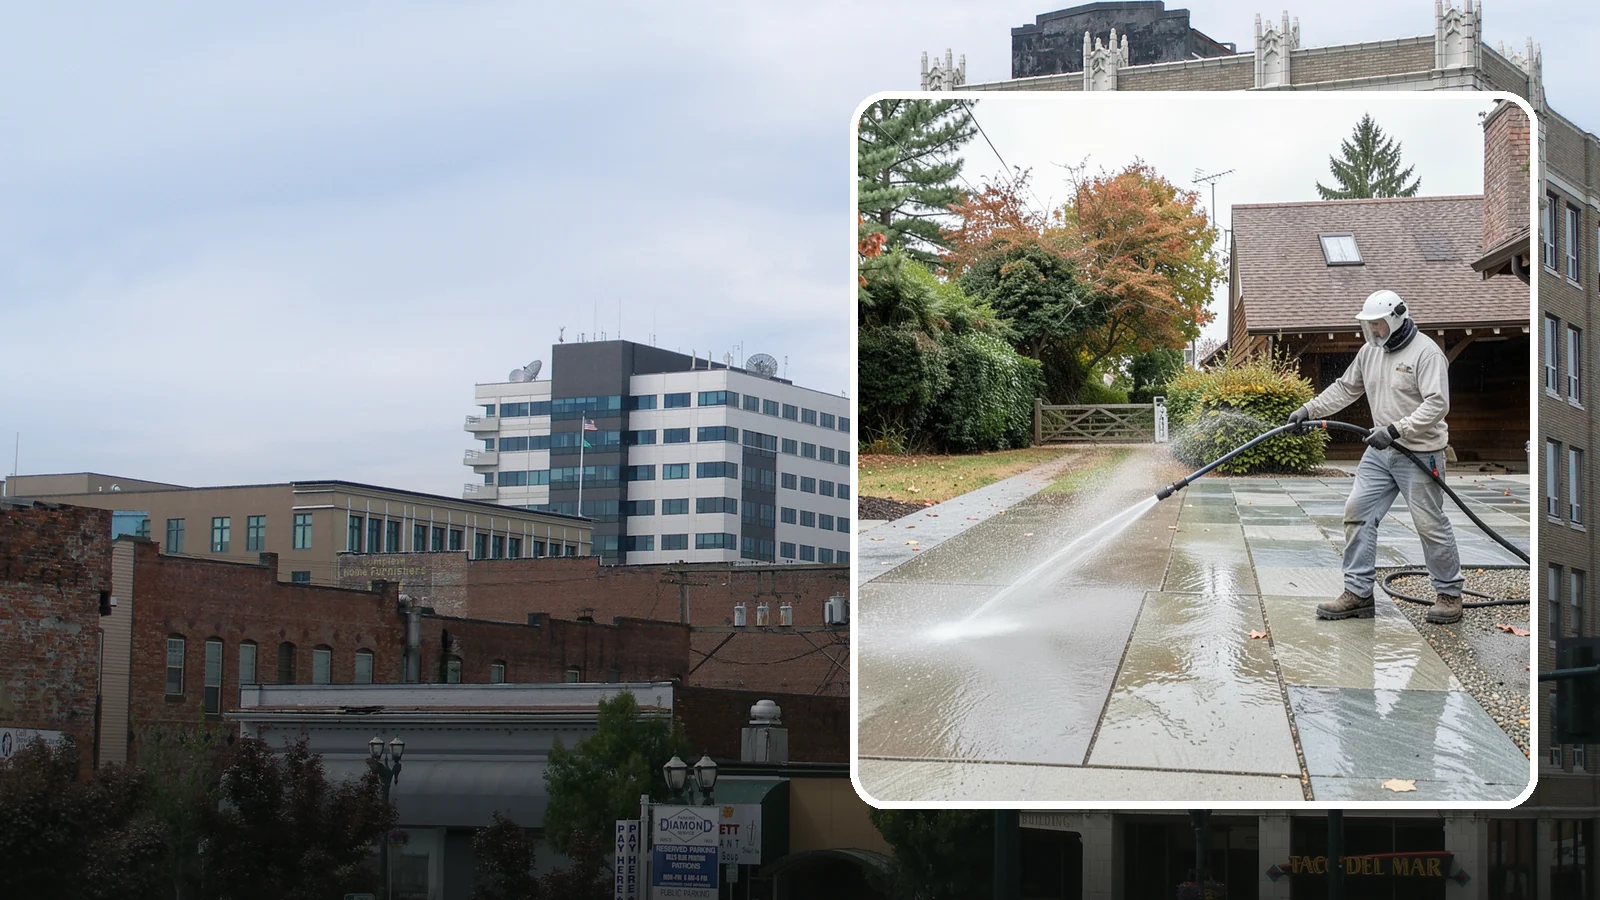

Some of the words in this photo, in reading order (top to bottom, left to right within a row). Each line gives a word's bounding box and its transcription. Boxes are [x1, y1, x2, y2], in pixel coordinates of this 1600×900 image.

[343, 568, 368, 577] Home
[660, 818, 713, 833] DIAMOND
[1022, 815, 1070, 828] BUILDING
[617, 824, 625, 853] PAY
[628, 824, 637, 853] PAY
[656, 845, 688, 853] RESERVED
[722, 851, 739, 863] Soup
[671, 862, 701, 870] PATRONS
[1346, 857, 1385, 875] DEL
[1392, 857, 1442, 877] MAR
[616, 856, 625, 894] HERE
[627, 855, 637, 894] HERE
[660, 888, 682, 897] PUBLIC
[683, 889, 710, 898] PARKING
